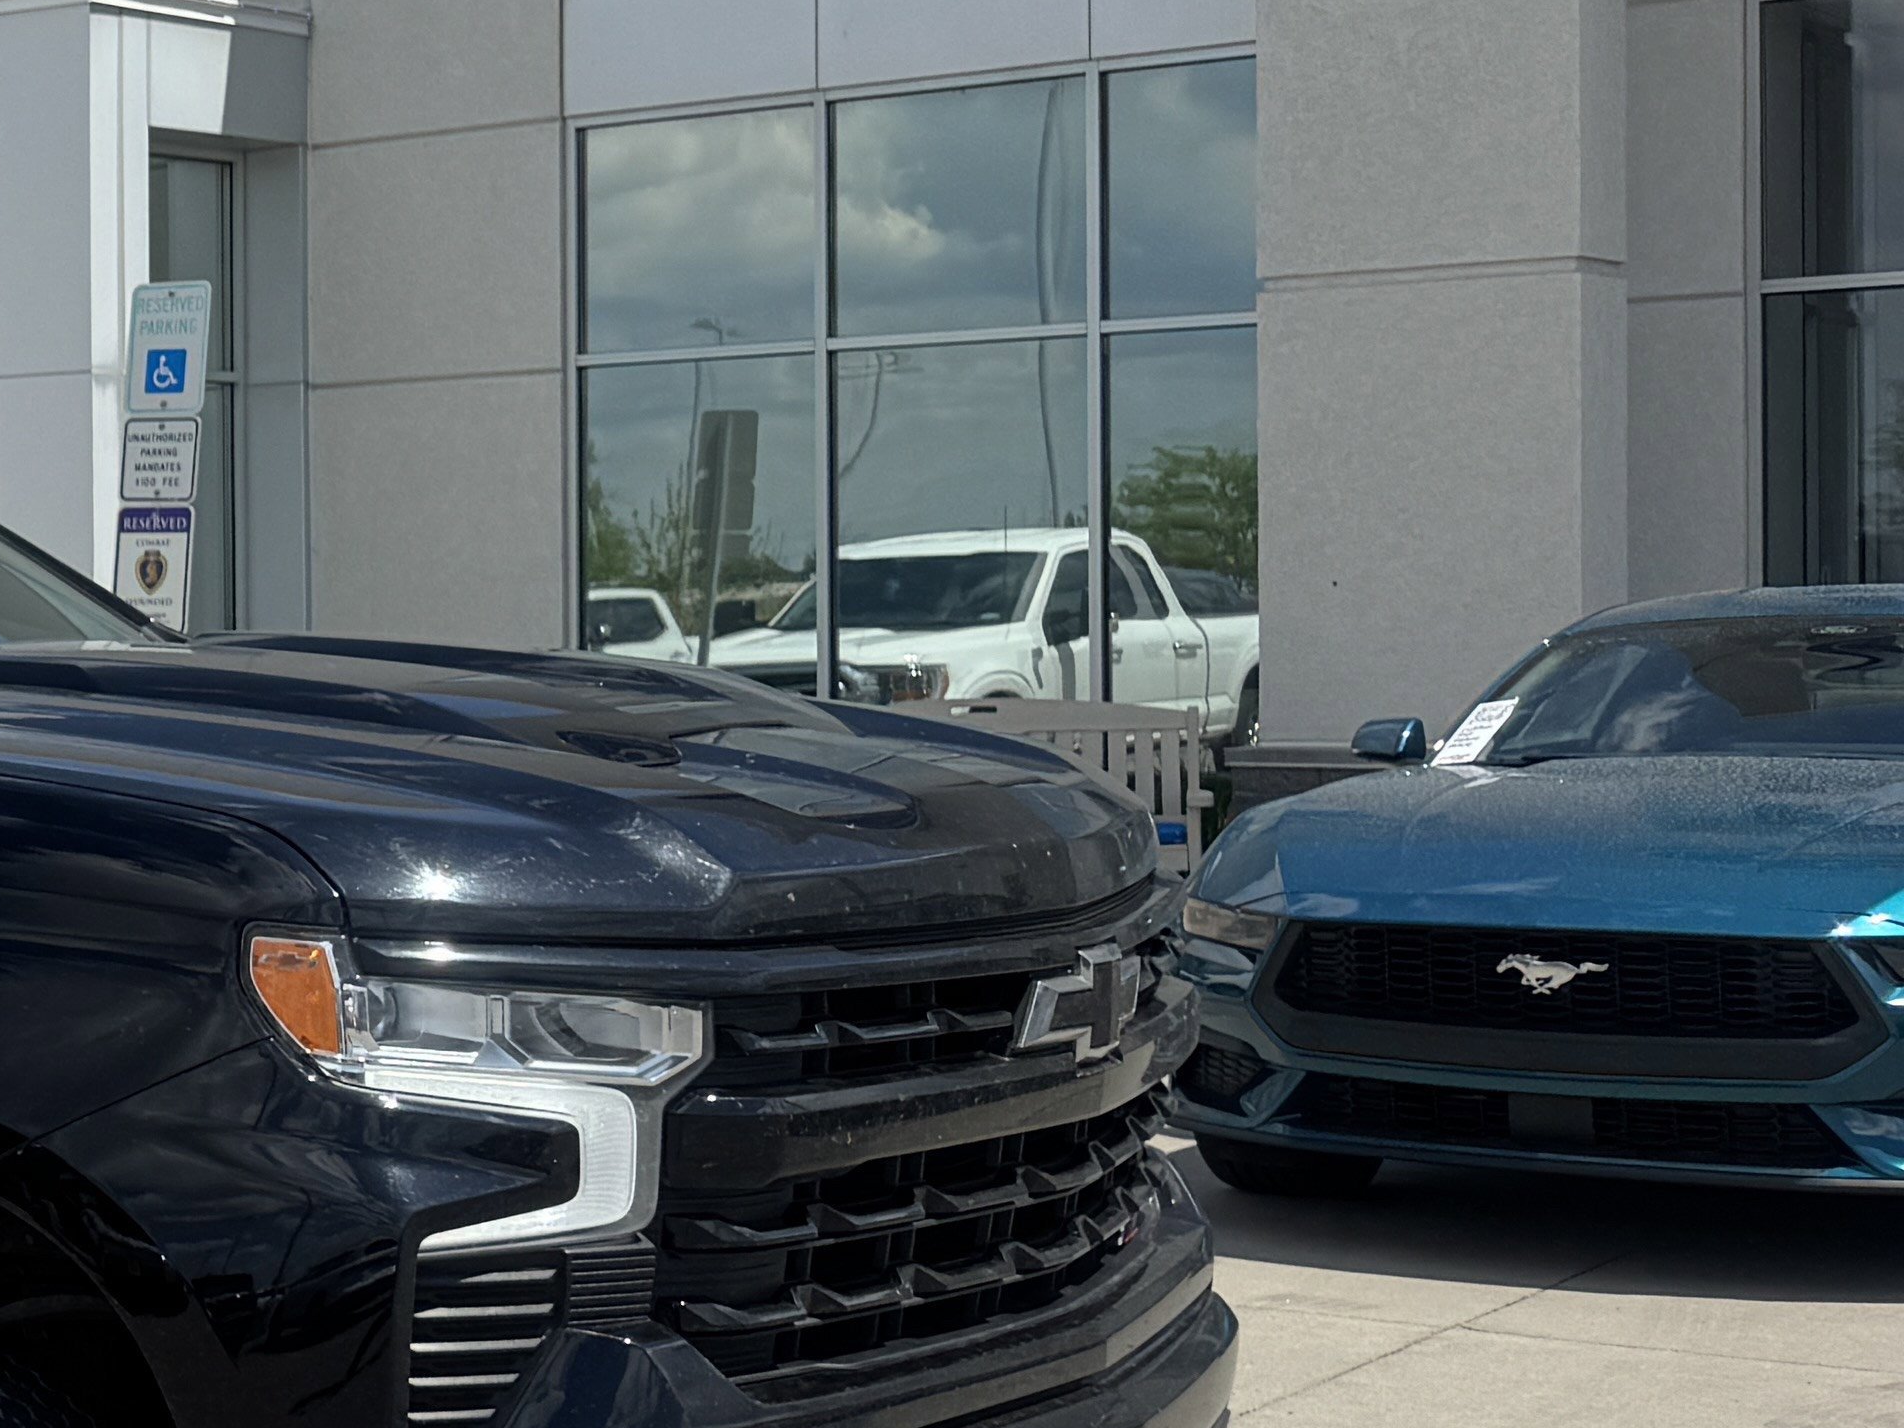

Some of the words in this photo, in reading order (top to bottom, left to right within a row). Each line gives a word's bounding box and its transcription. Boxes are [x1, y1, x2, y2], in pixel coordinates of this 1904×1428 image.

[139, 295, 205, 313] RESERVED
[140, 317, 199, 335] PARKING
[127, 432, 194, 443] UNAUTHORIZED
[140, 447, 178, 457] PARKING
[134, 461, 181, 472] MANDATES
[162, 476, 180, 487] FEE
[123, 516, 187, 530] RESERVED
